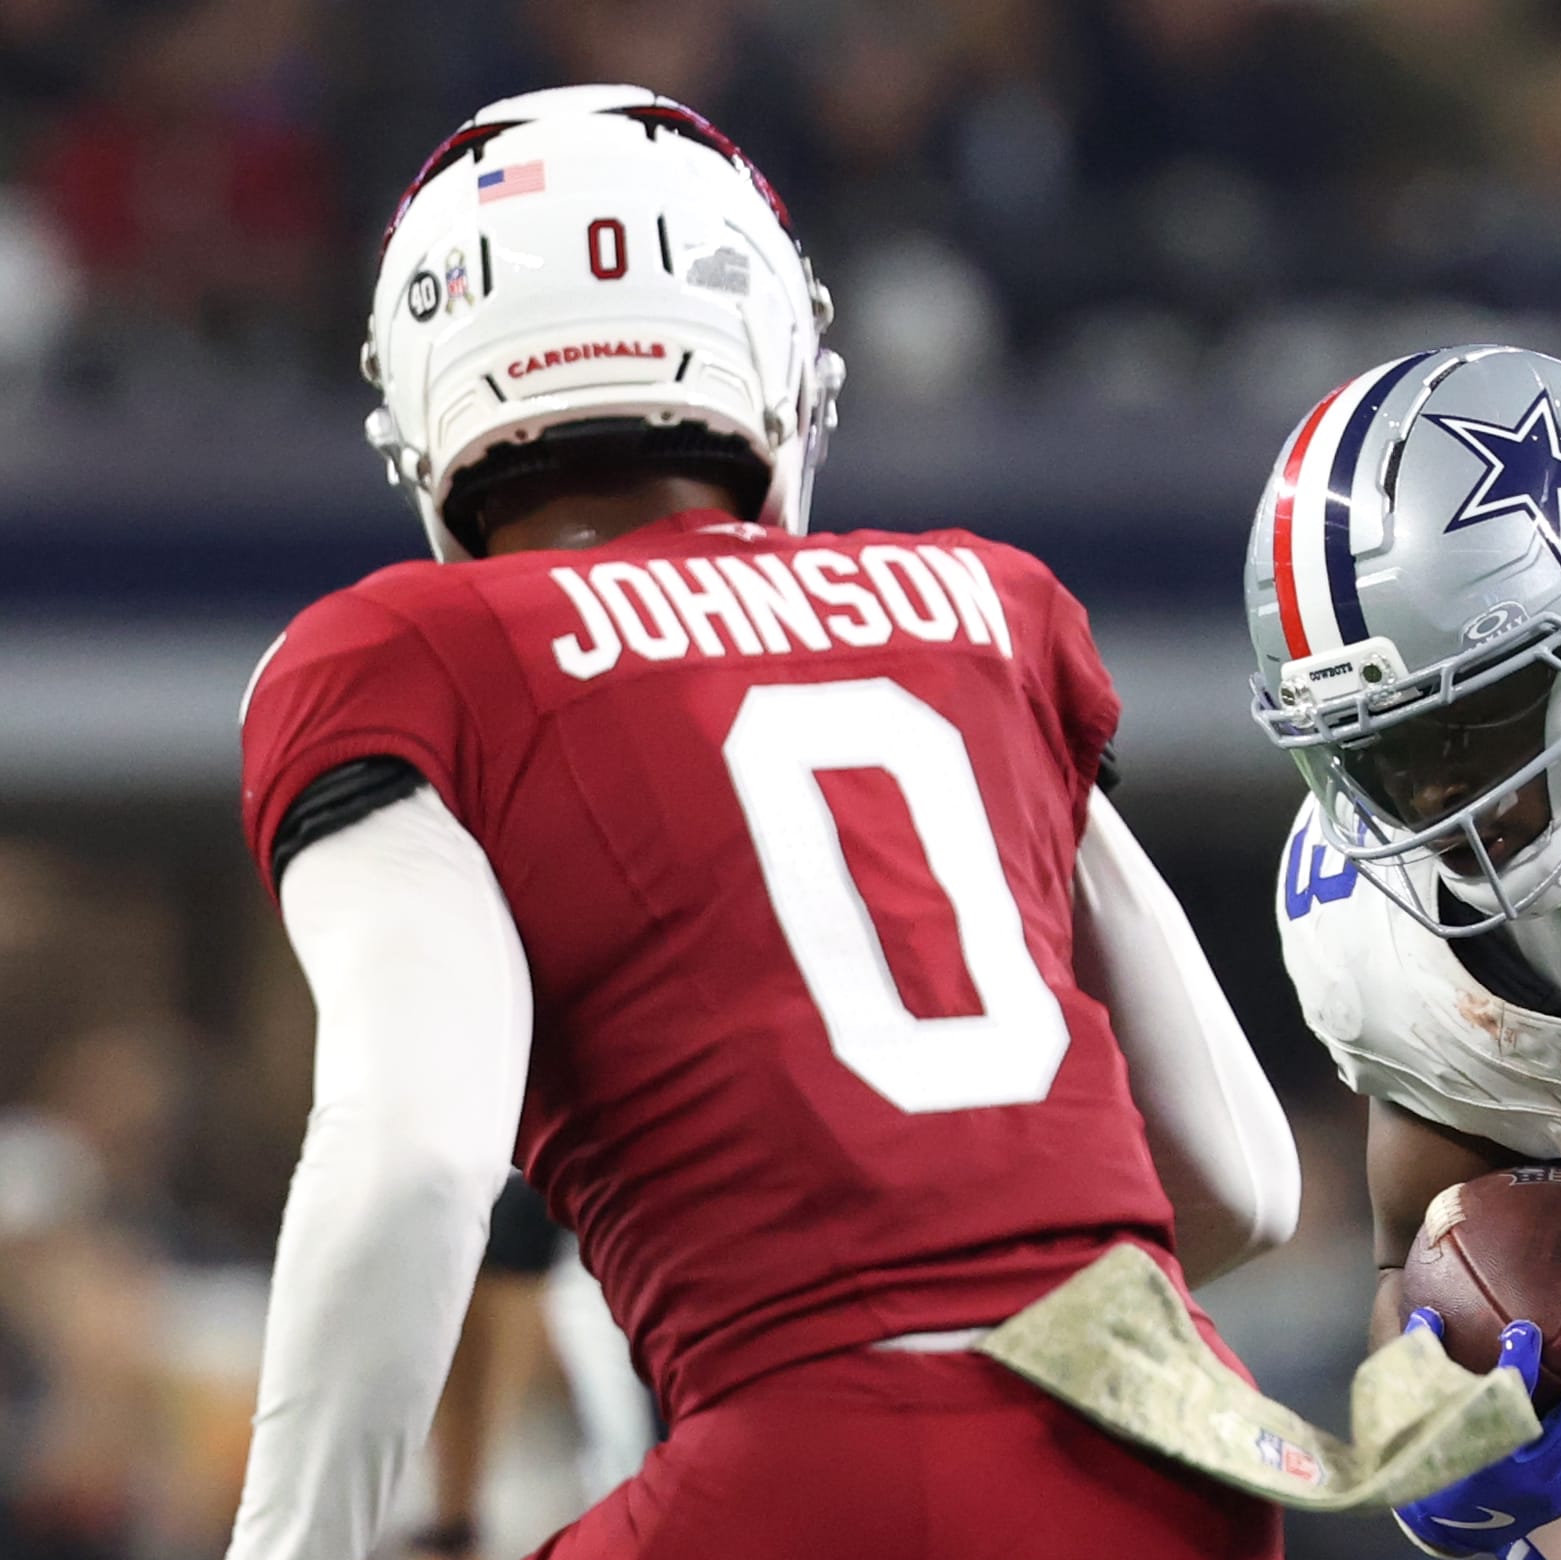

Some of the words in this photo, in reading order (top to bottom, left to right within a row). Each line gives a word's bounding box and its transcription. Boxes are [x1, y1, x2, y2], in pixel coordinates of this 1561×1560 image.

[588, 218, 627, 280] 0
[410, 276, 437, 316] 40
[507, 341, 667, 379] CARDINALS
[549, 545, 1013, 681] JOHNSON
[1309, 662, 1353, 682] COWBOYS
[722, 677, 1070, 1114] 0
